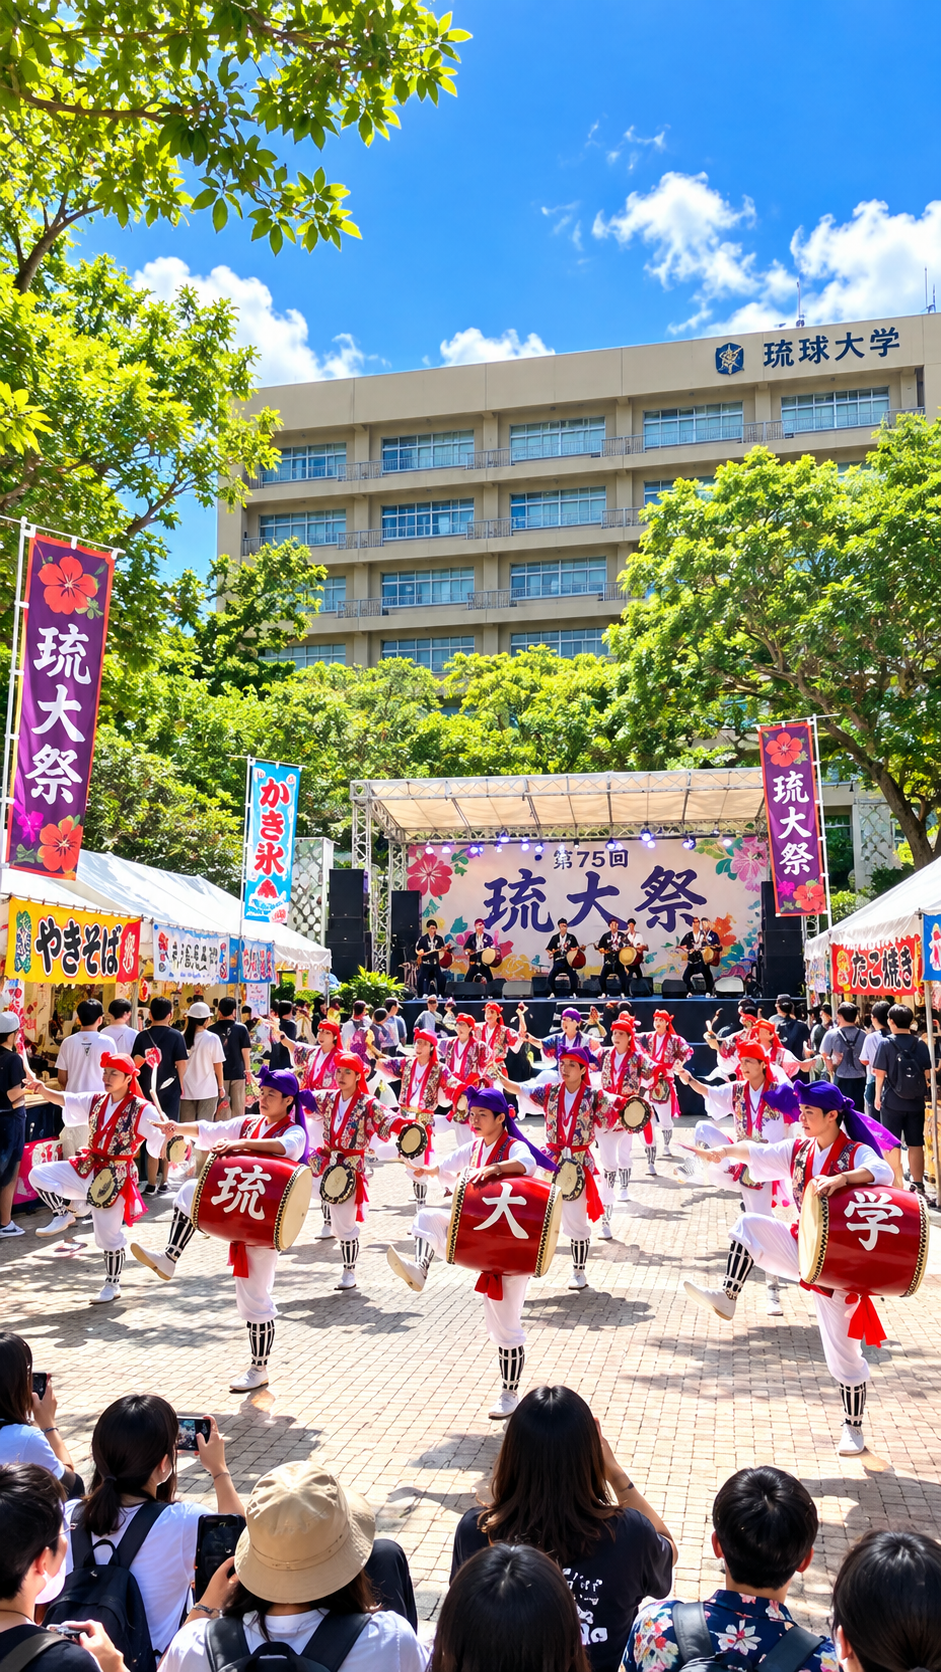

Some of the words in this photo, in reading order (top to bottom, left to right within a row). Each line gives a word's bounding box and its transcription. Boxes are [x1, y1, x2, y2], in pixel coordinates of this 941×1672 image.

[763, 326, 900, 368] 琉球大学
[25, 623, 92, 805] 琉大祭
[253, 778, 290, 876] かき氷
[773, 770, 815, 876] 琉大祭
[553, 849, 629, 870] 第75回
[483, 865, 708, 933] 琉大祭
[35, 916, 122, 976] やきそば
[851, 945, 913, 989] たこ焼き
[210, 1164, 272, 1221] 琉
[473, 1182, 530, 1240] 大
[844, 1191, 904, 1252] 学
